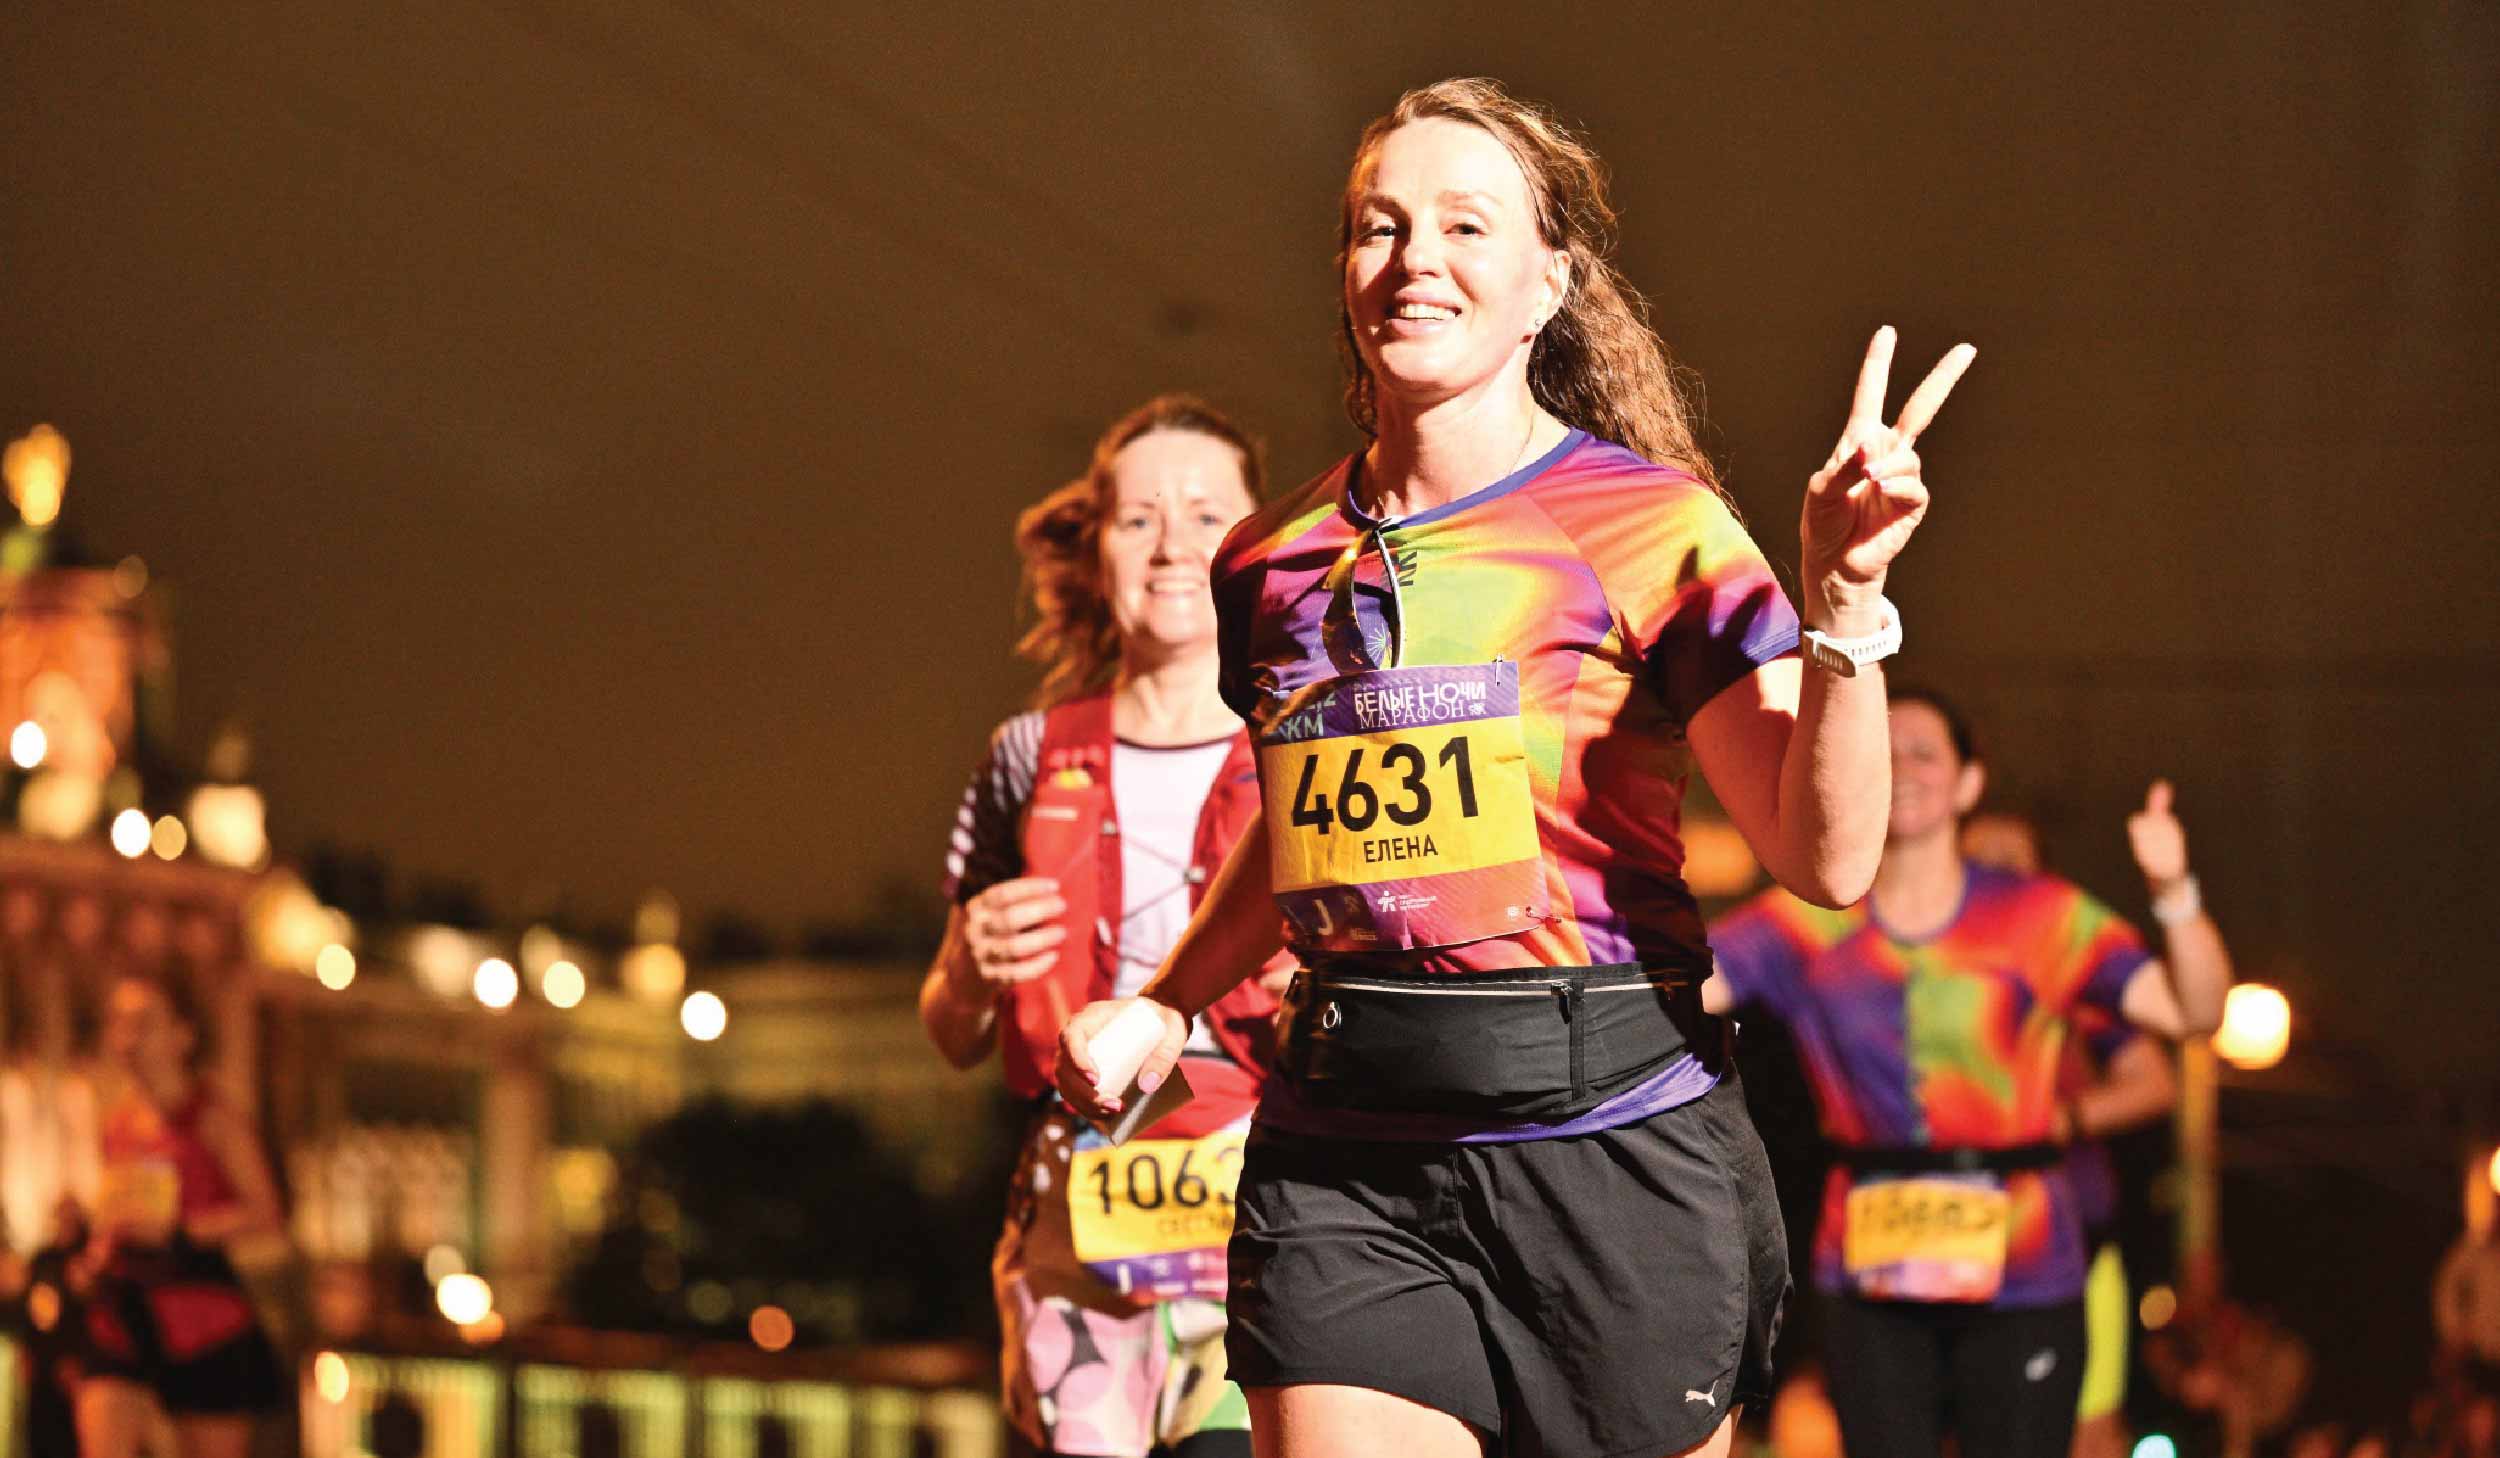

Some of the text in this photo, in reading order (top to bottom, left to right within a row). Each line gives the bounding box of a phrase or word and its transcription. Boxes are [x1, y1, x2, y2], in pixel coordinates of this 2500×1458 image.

[1419, 681, 1487, 705] НОЧИ
[1287, 712, 1325, 741] КМ
[1359, 701, 1465, 730] МАРАФОН
[1293, 735, 1479, 835] 4631
[1363, 833, 1439, 863] ЕЛЕНА
